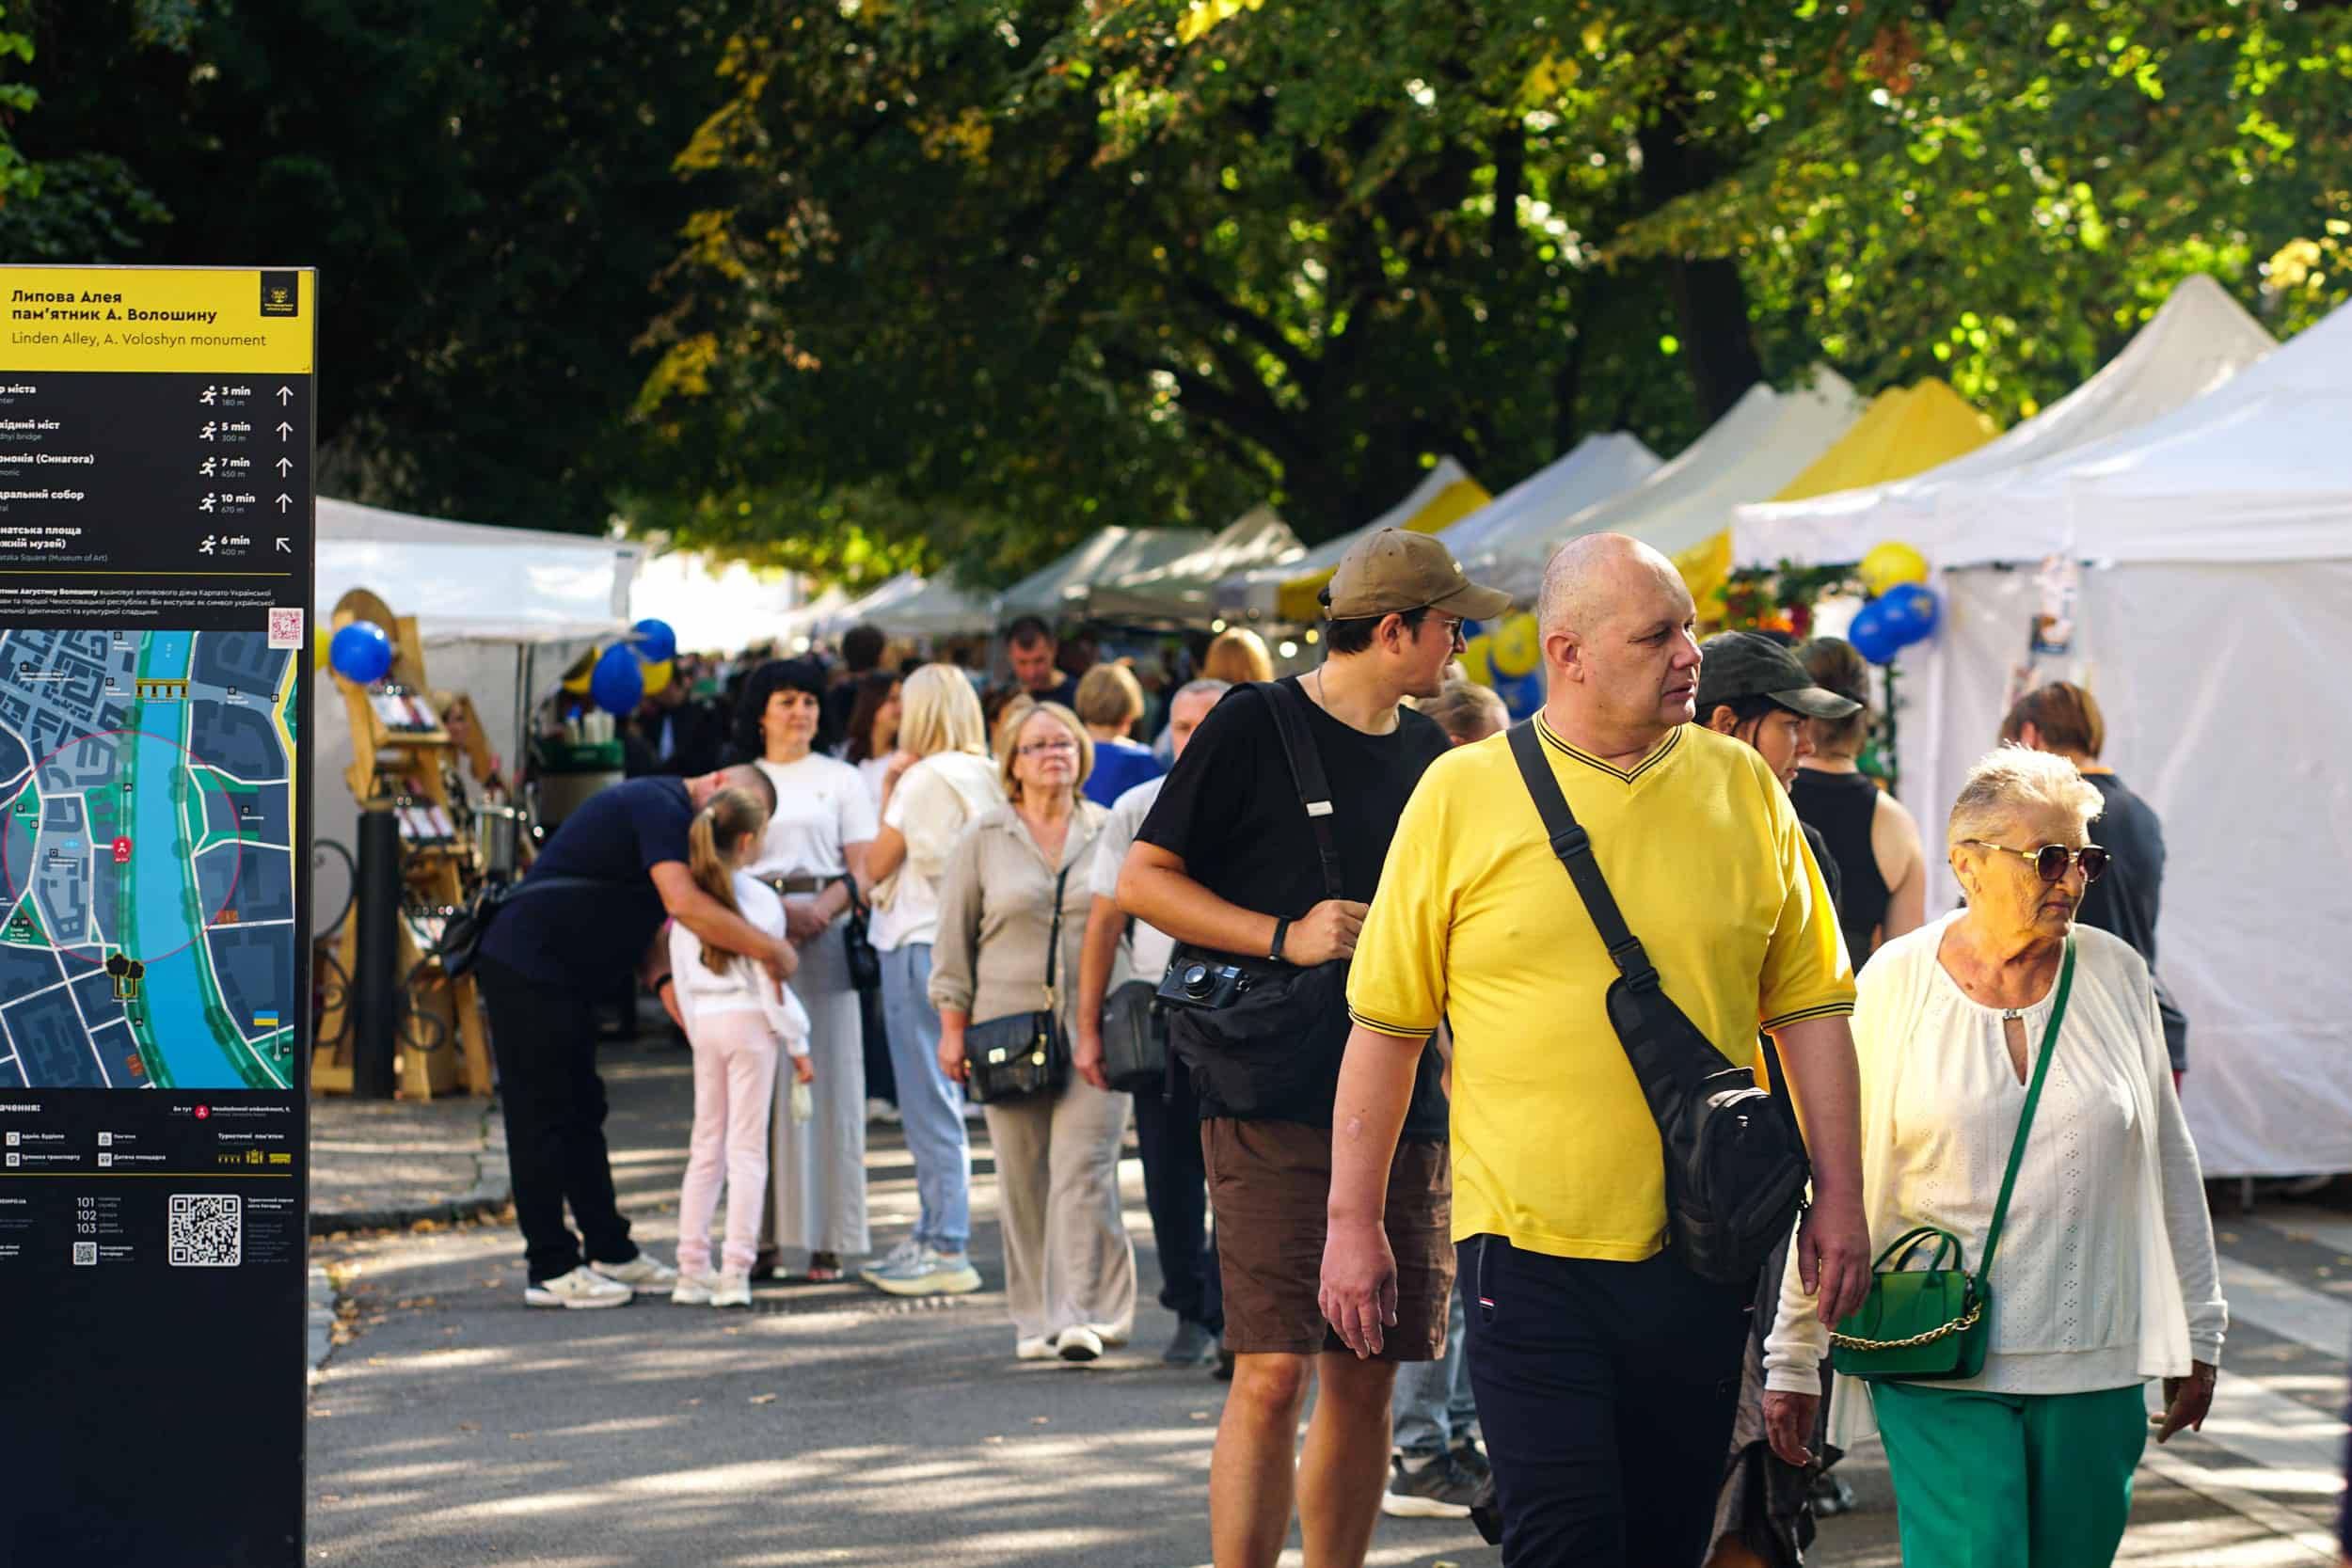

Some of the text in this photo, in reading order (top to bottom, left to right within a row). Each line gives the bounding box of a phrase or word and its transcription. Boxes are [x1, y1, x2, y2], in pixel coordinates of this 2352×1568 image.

[11, 290, 122, 304] Липова Алея
[12, 307, 217, 325] пам'ятник А. Волошину
[12, 333, 266, 348] Linden Alley, A. Voloshyn monument
[8, 384, 37, 394] міста
[221, 386, 251, 396] 3 min
[38, 420, 60, 431] міст
[221, 421, 251, 431] 5 min
[37, 453, 94, 465] (Синагога)
[221, 457, 250, 467] 7 min
[51, 490, 85, 501] собор
[221, 493, 256, 503] 10 min
[45, 528, 82, 536] площа
[30, 538, 67, 549] музей)
[220, 535, 250, 546] 6 min
[77, 1197, 94, 1208] 101
[77, 1211, 97, 1221] 102
[77, 1224, 97, 1234] 103
